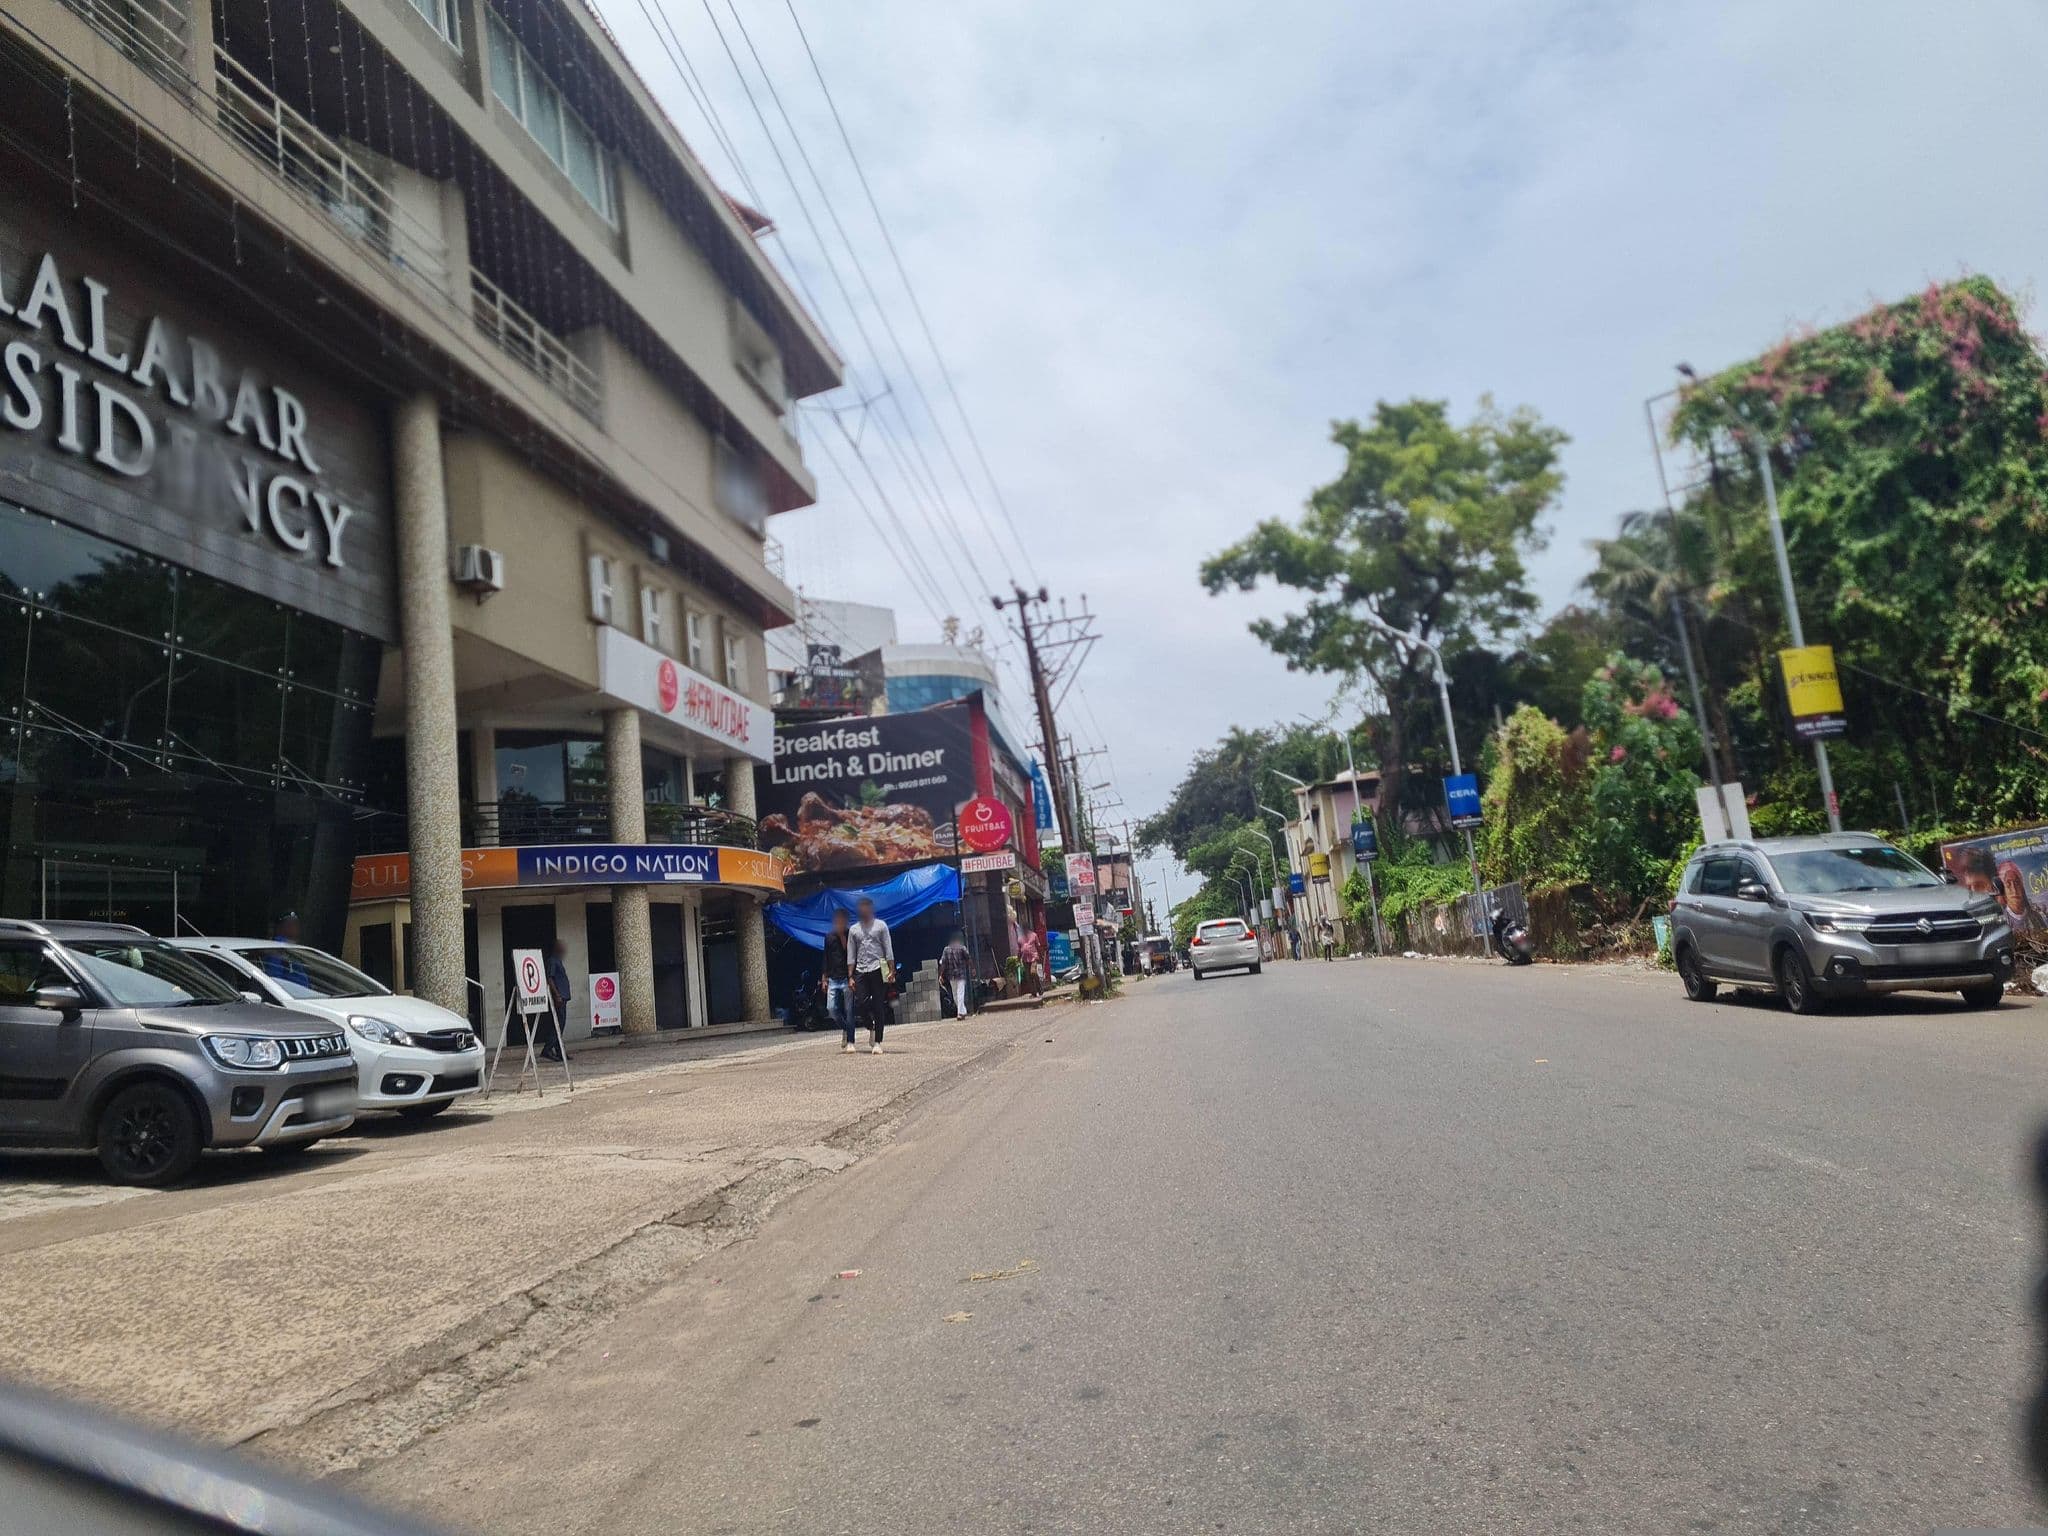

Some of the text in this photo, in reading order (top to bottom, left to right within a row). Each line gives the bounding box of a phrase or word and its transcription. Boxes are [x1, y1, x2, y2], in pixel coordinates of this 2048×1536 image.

[0, 251, 319, 474] ALABAR
[773, 726, 880, 756] Breakfast
[771, 748, 945, 785] Lunch & Dinner
[965, 820, 1006, 834] FRUITBAE
[536, 854, 709, 875] INDIGO NATION
[963, 855, 1013, 872] #FRUITBAE
